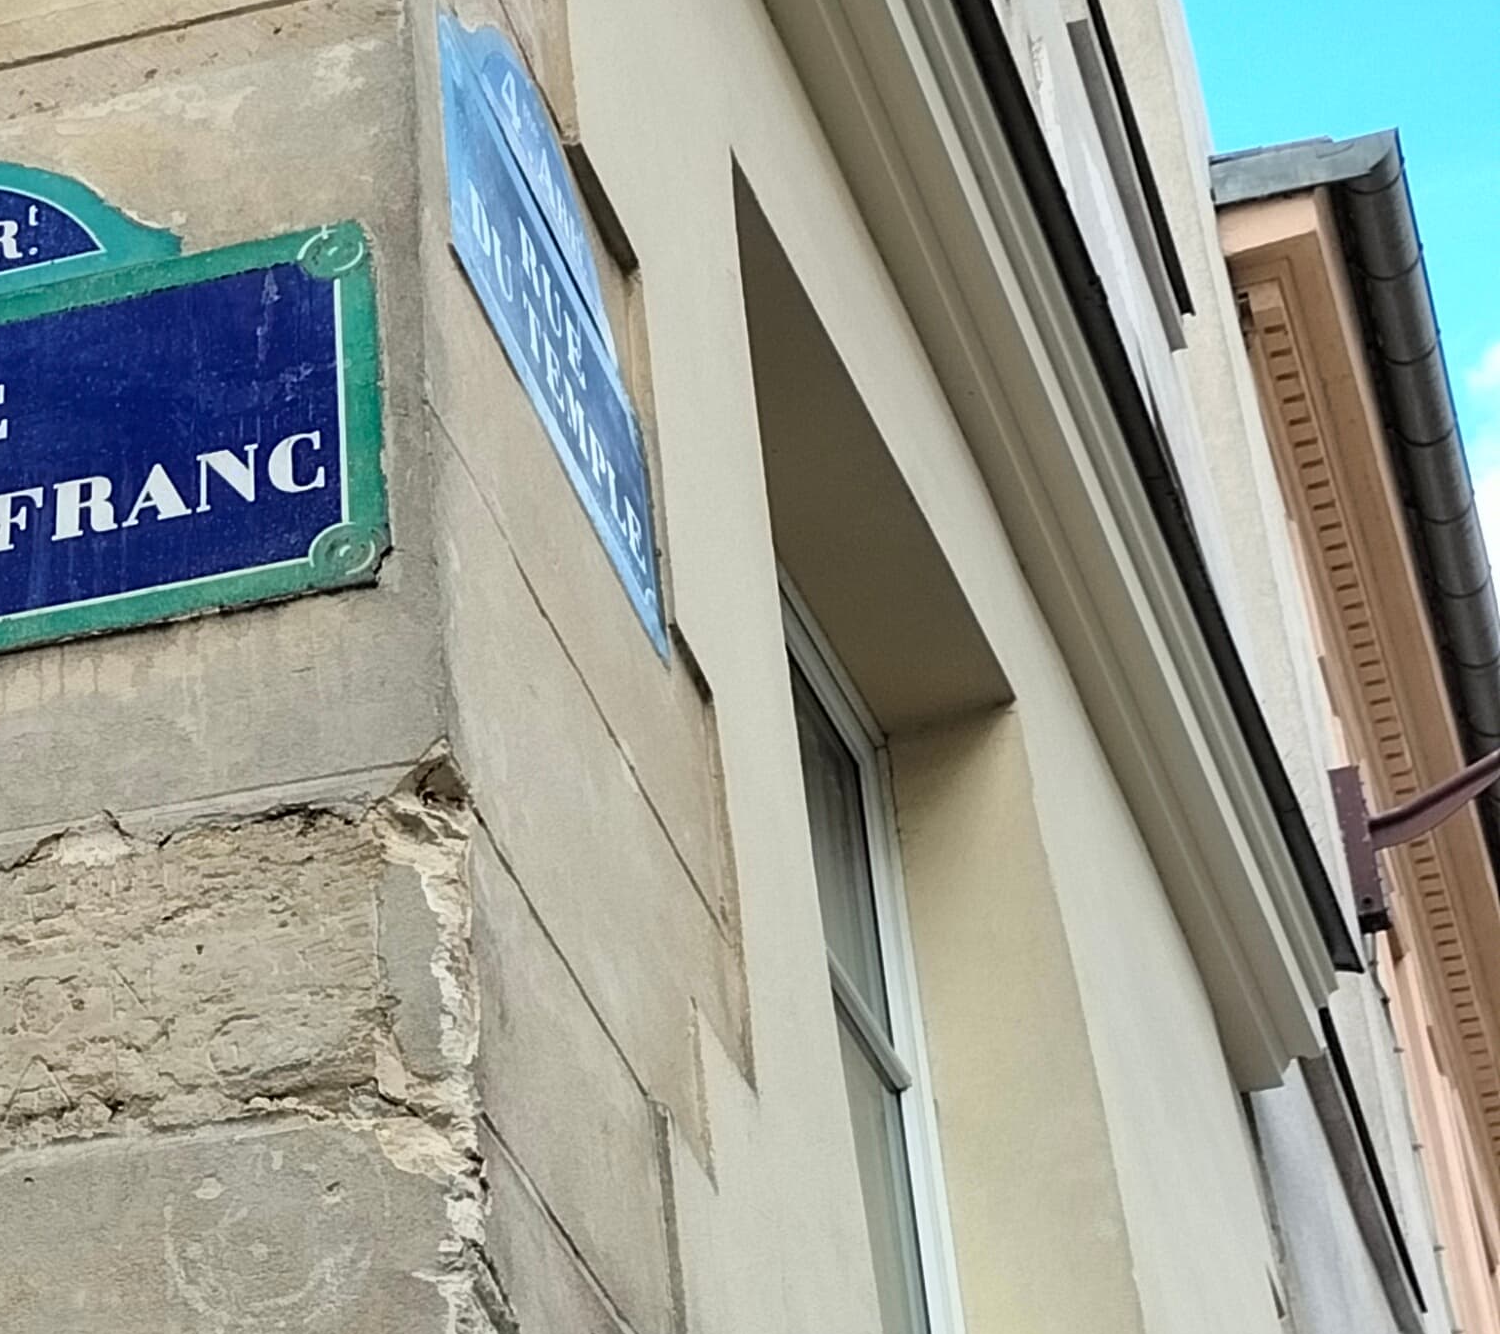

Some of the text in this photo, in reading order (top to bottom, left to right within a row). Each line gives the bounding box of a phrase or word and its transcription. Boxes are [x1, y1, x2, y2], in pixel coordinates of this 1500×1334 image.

[467, 179, 647, 574] DU TEMPLE
[517, 216, 587, 390] RUE
